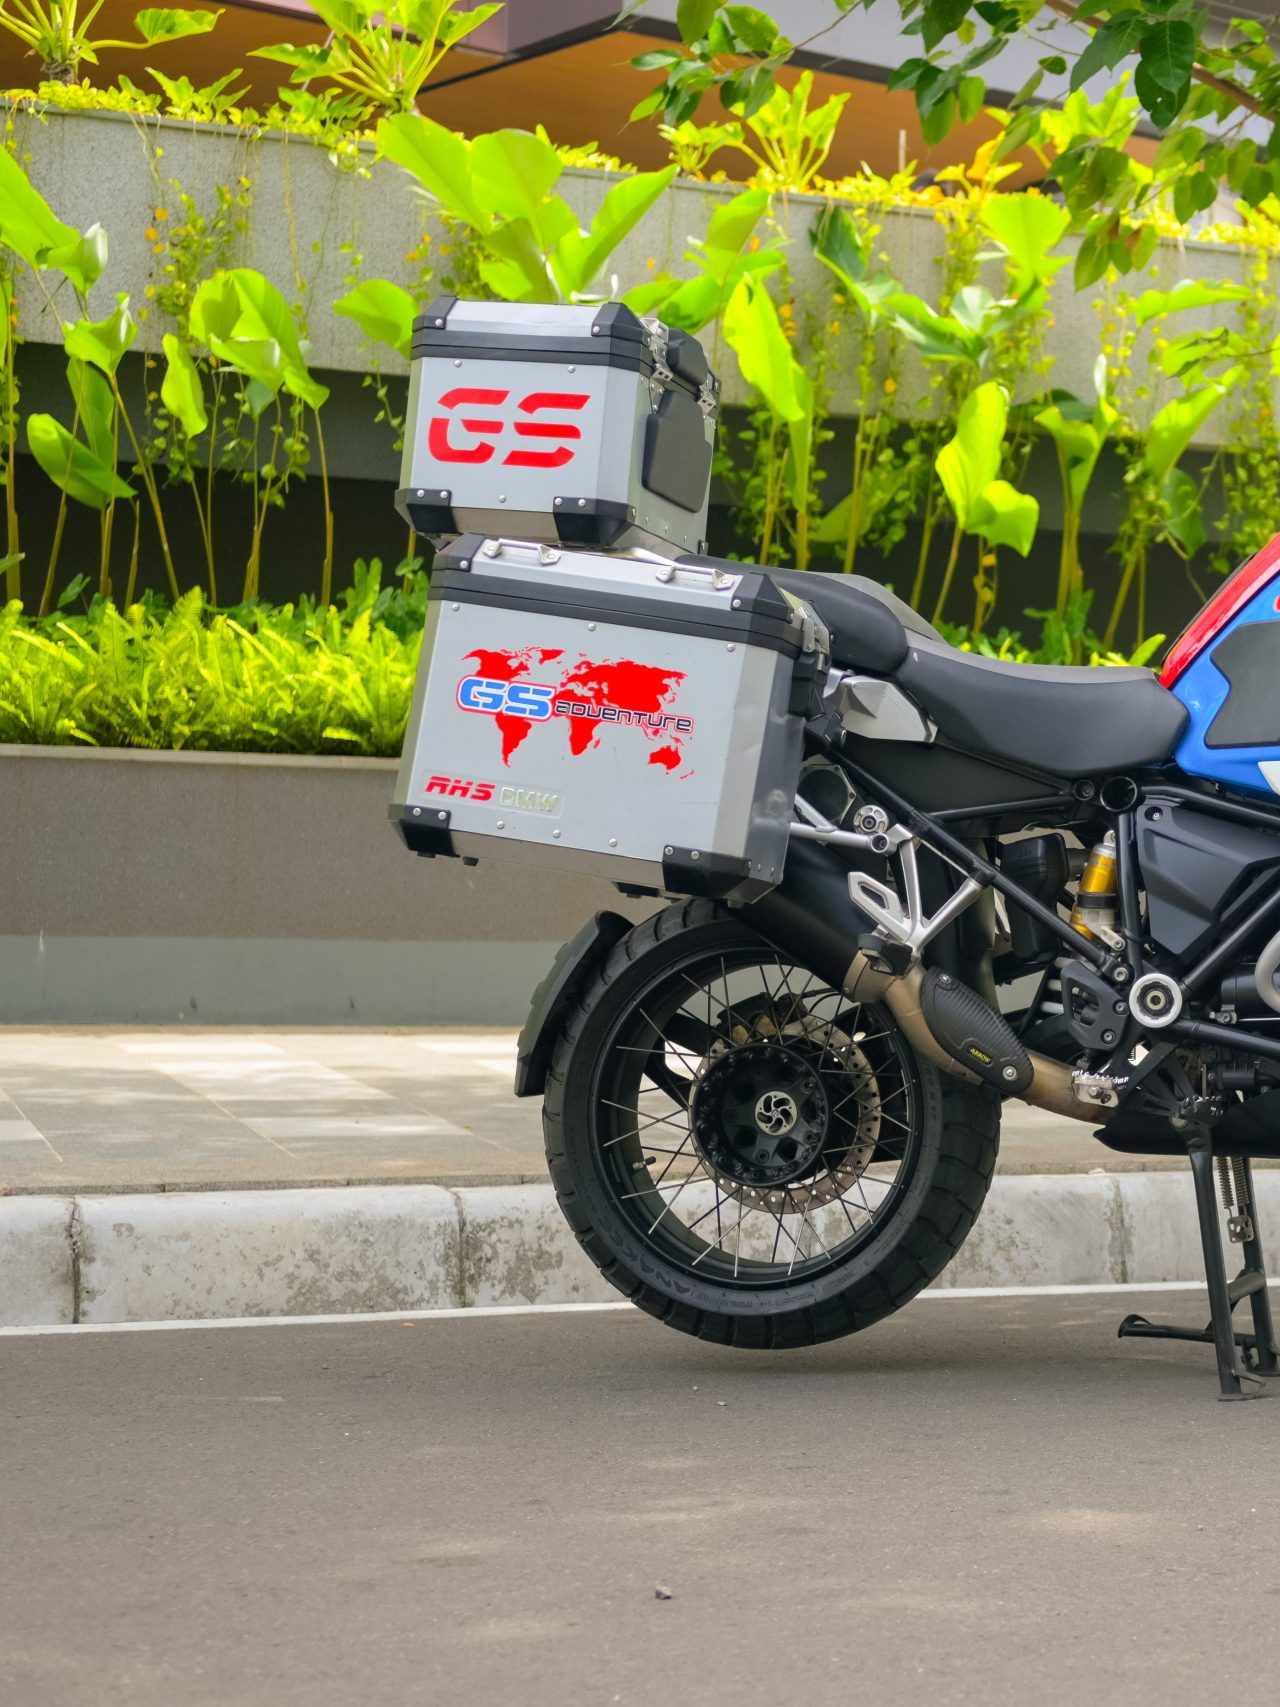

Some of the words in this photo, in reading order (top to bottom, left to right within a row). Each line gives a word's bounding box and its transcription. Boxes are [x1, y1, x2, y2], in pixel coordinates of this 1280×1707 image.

[428, 387, 591, 469] GS
[459, 677, 553, 718] GS
[425, 775, 496, 801] RHS
[499, 787, 560, 812] BMW
[970, 1048, 991, 1063] ARROW
